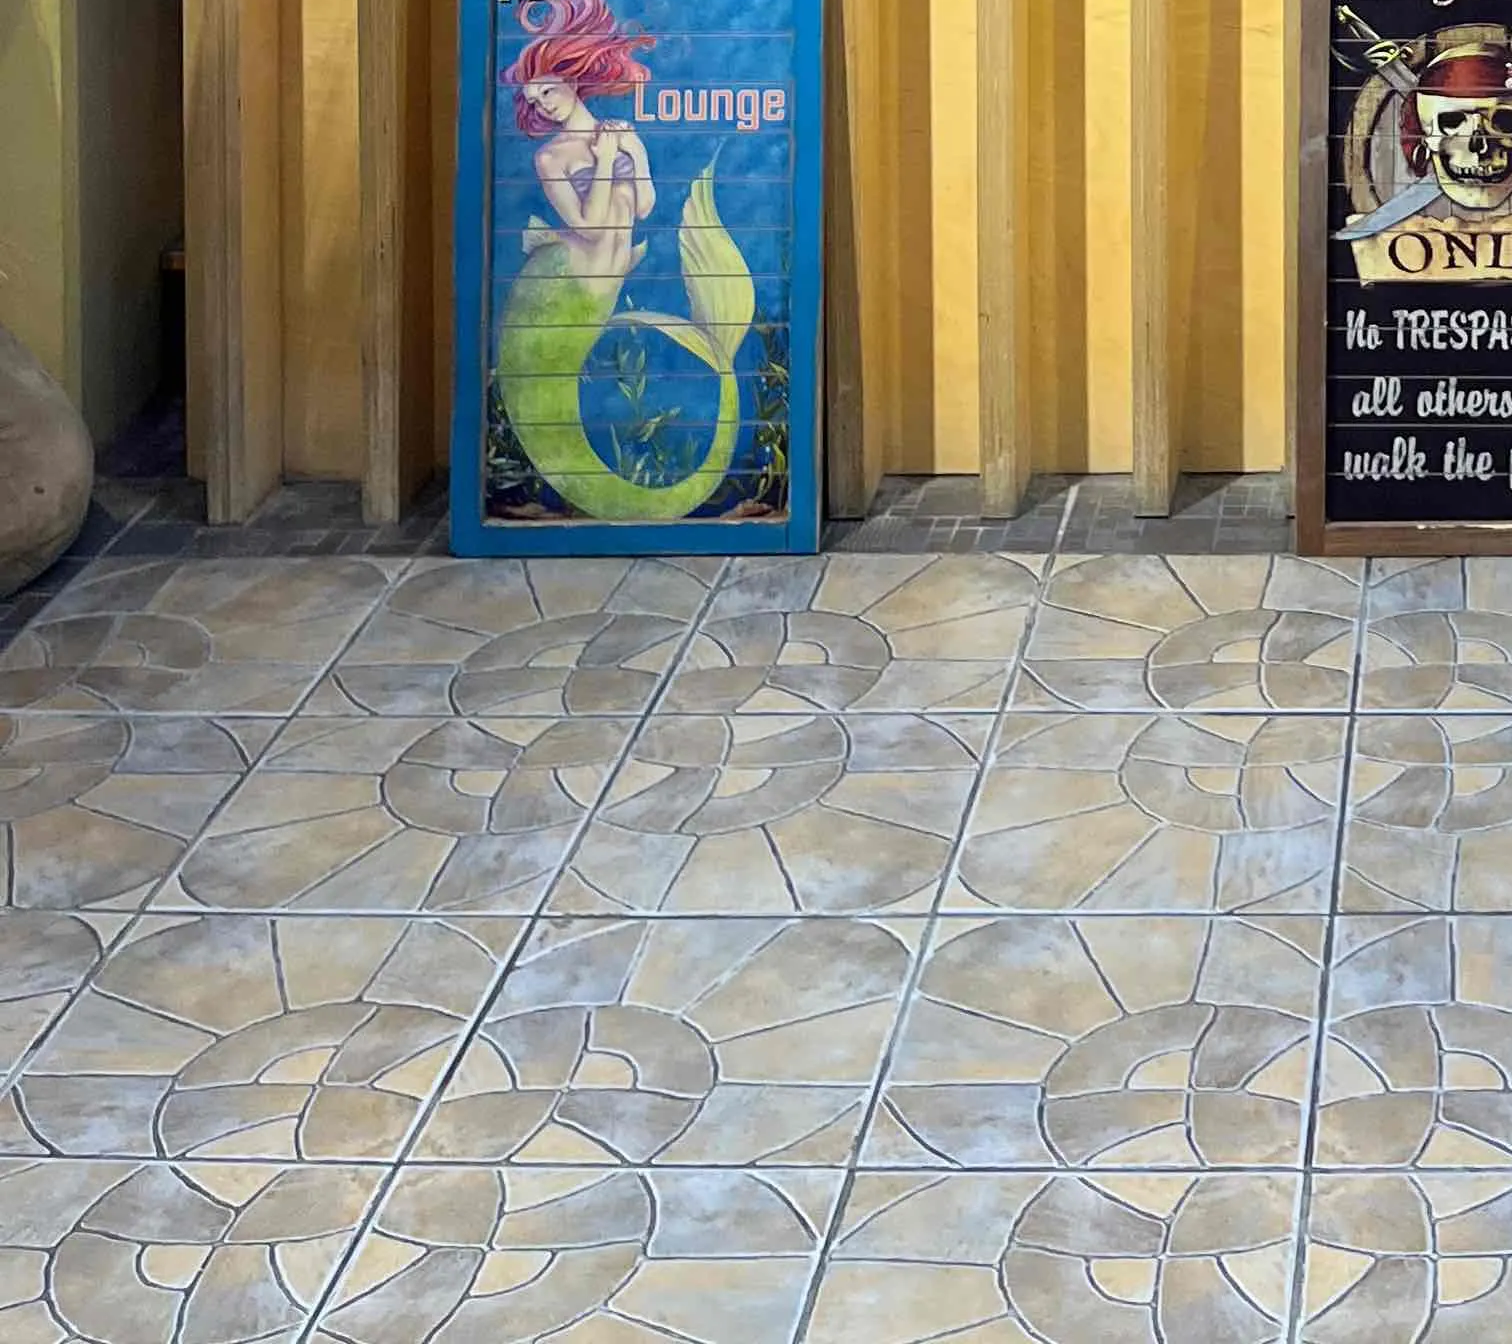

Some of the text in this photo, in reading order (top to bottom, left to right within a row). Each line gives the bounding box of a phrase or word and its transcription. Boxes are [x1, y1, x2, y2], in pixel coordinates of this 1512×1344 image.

[634, 75, 785, 130] Lounge
[1346, 310, 1383, 350] No
[1352, 376, 1404, 417] all
[1343, 436, 1429, 481] walk
[1444, 436, 1496, 481] the
